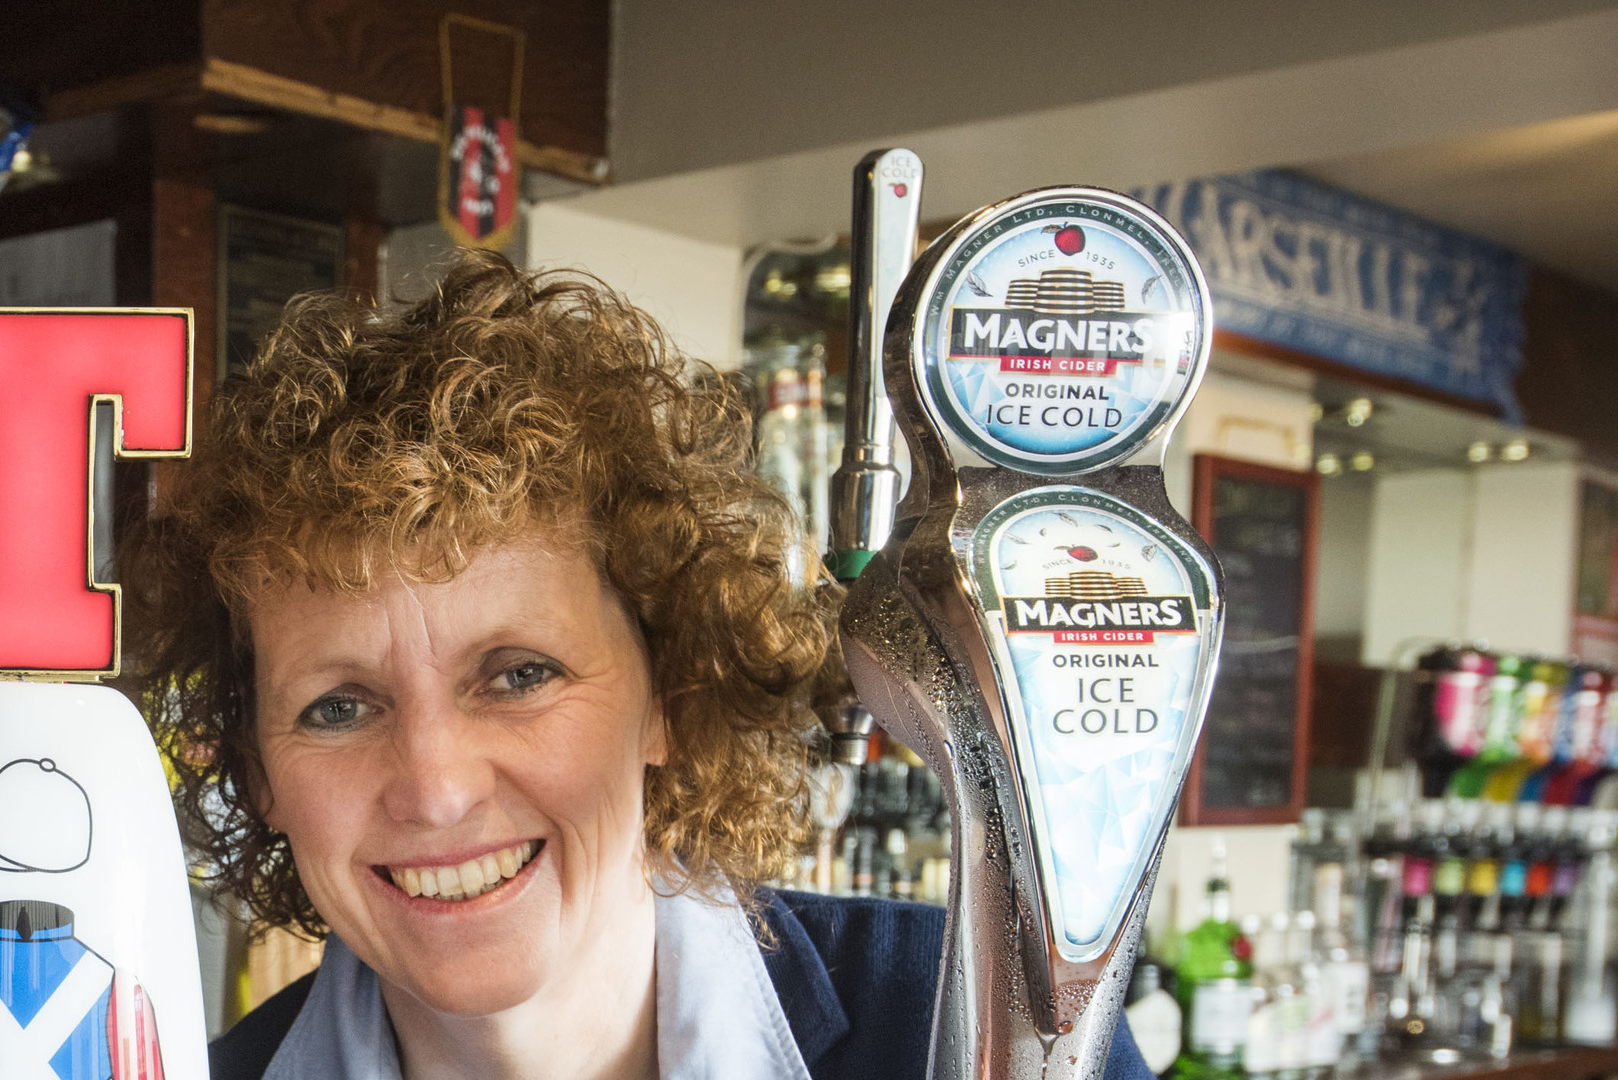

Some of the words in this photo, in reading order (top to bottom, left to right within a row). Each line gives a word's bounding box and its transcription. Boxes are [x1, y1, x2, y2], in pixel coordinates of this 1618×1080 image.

[891, 156, 912, 168] ICE
[945, 224, 1003, 280] MAGNER
[1065, 204, 1150, 245] CLONMEL,
[1018, 249, 1056, 268] SINCE
[1086, 251, 1116, 271] 1935
[964, 313, 1155, 354] MAGNERS
[1010, 358, 1052, 370] IRISH
[1059, 358, 1106, 372] CIDER
[1005, 383, 1110, 401] ORIGINAL
[986, 404, 1032, 426] ICE
[1041, 406, 1122, 428] COLD
[1042, 559, 1073, 570] SINCE
[1101, 558, 1131, 570] 1935
[1014, 599, 1183, 629] MAGNERS
[1061, 632, 1098, 641] IRISH
[1103, 632, 1144, 641] CIDER
[1052, 654, 1160, 668] ORIGINAL
[1078, 677, 1135, 704] ICE
[1052, 708, 1159, 735] COLD
